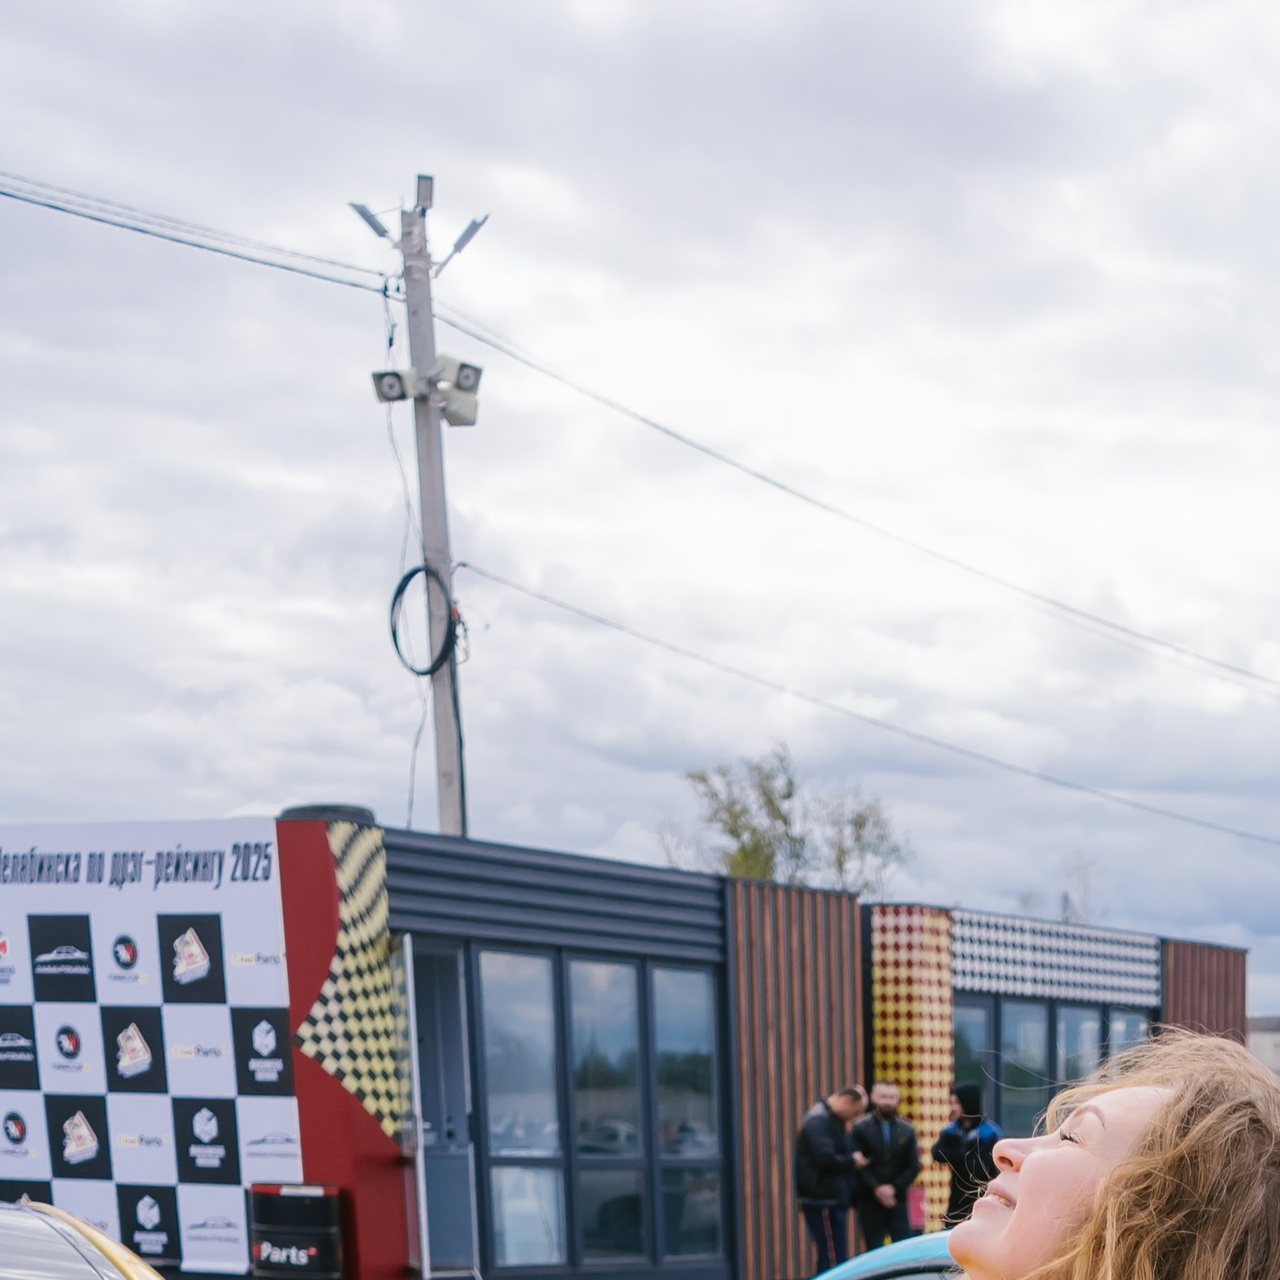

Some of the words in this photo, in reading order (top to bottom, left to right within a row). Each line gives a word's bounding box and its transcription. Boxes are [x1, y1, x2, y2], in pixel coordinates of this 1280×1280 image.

[0, 846, 81, 884] елябинска
[86, 851, 104, 884] по
[230, 842, 273, 882] 2025
[261, 1240, 309, 1266] Parts
